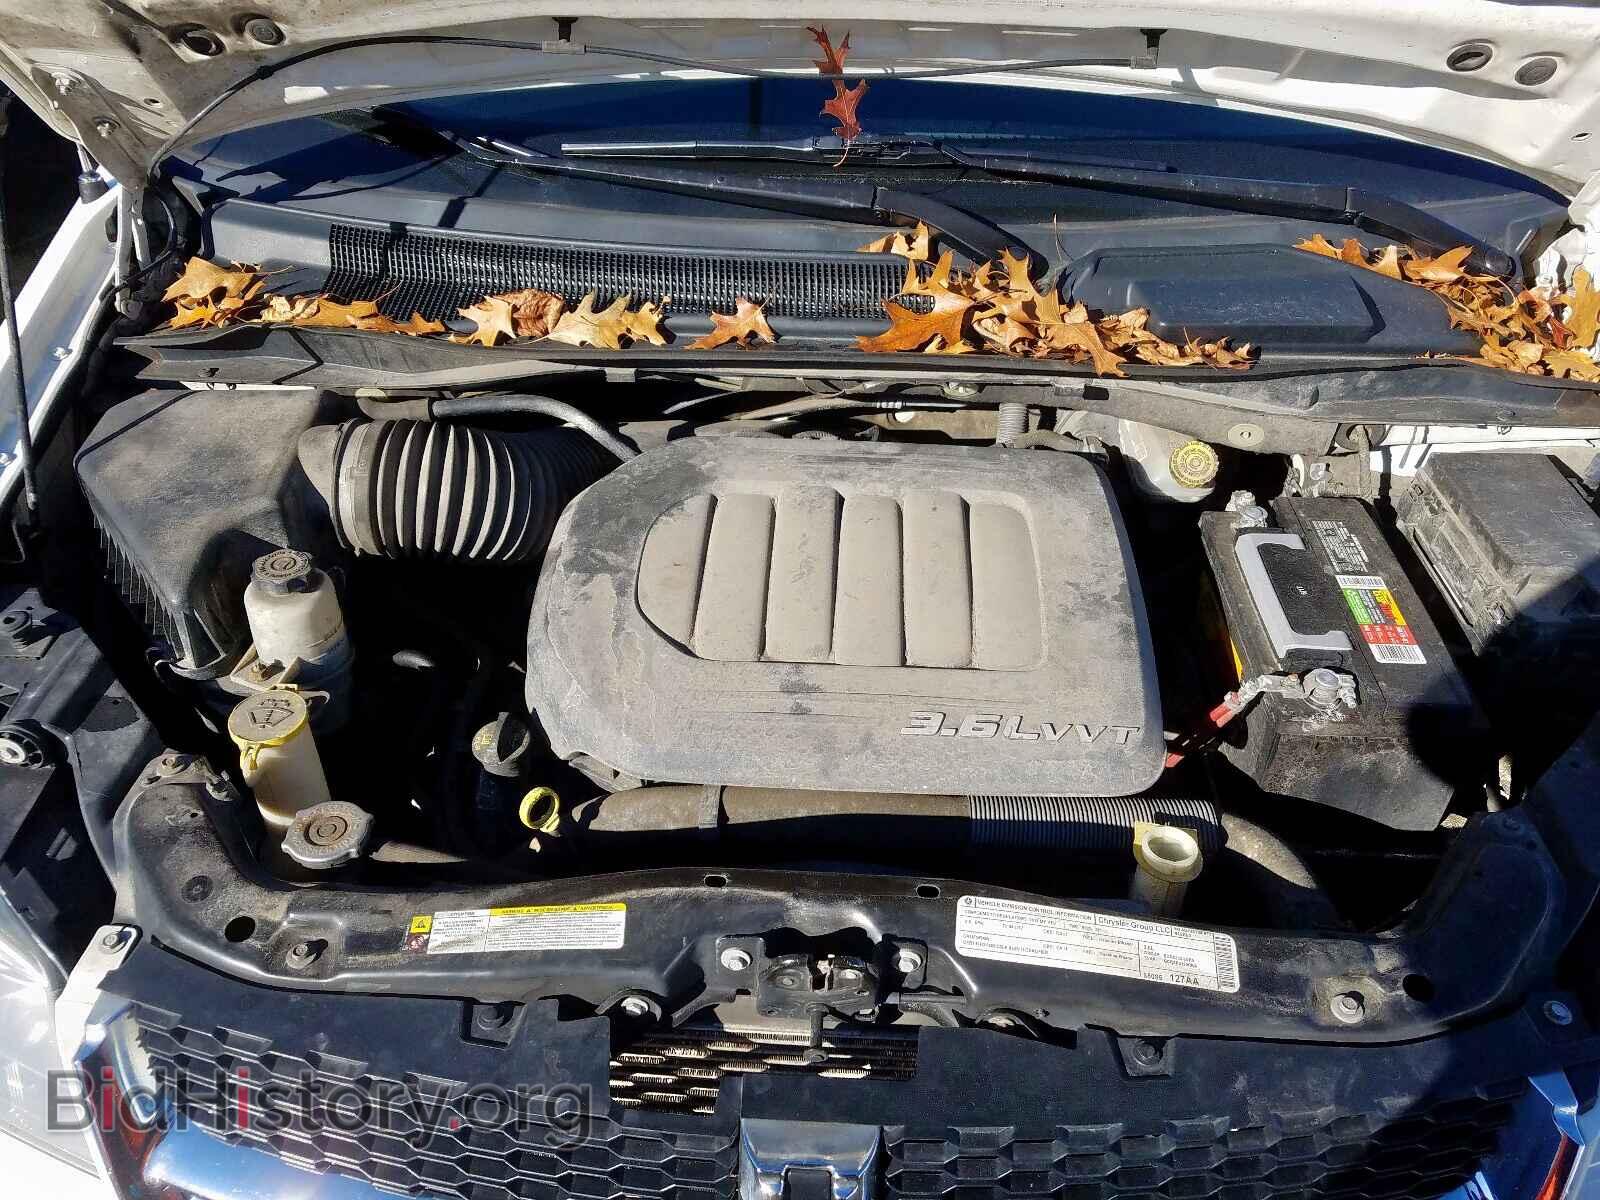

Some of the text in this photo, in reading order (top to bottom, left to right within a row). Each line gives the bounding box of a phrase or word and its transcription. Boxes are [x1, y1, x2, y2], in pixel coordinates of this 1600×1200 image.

[1130, 921, 1154, 933] Group
[1155, 925, 1171, 934] LLC
[1169, 973, 1200, 986] 127AA
